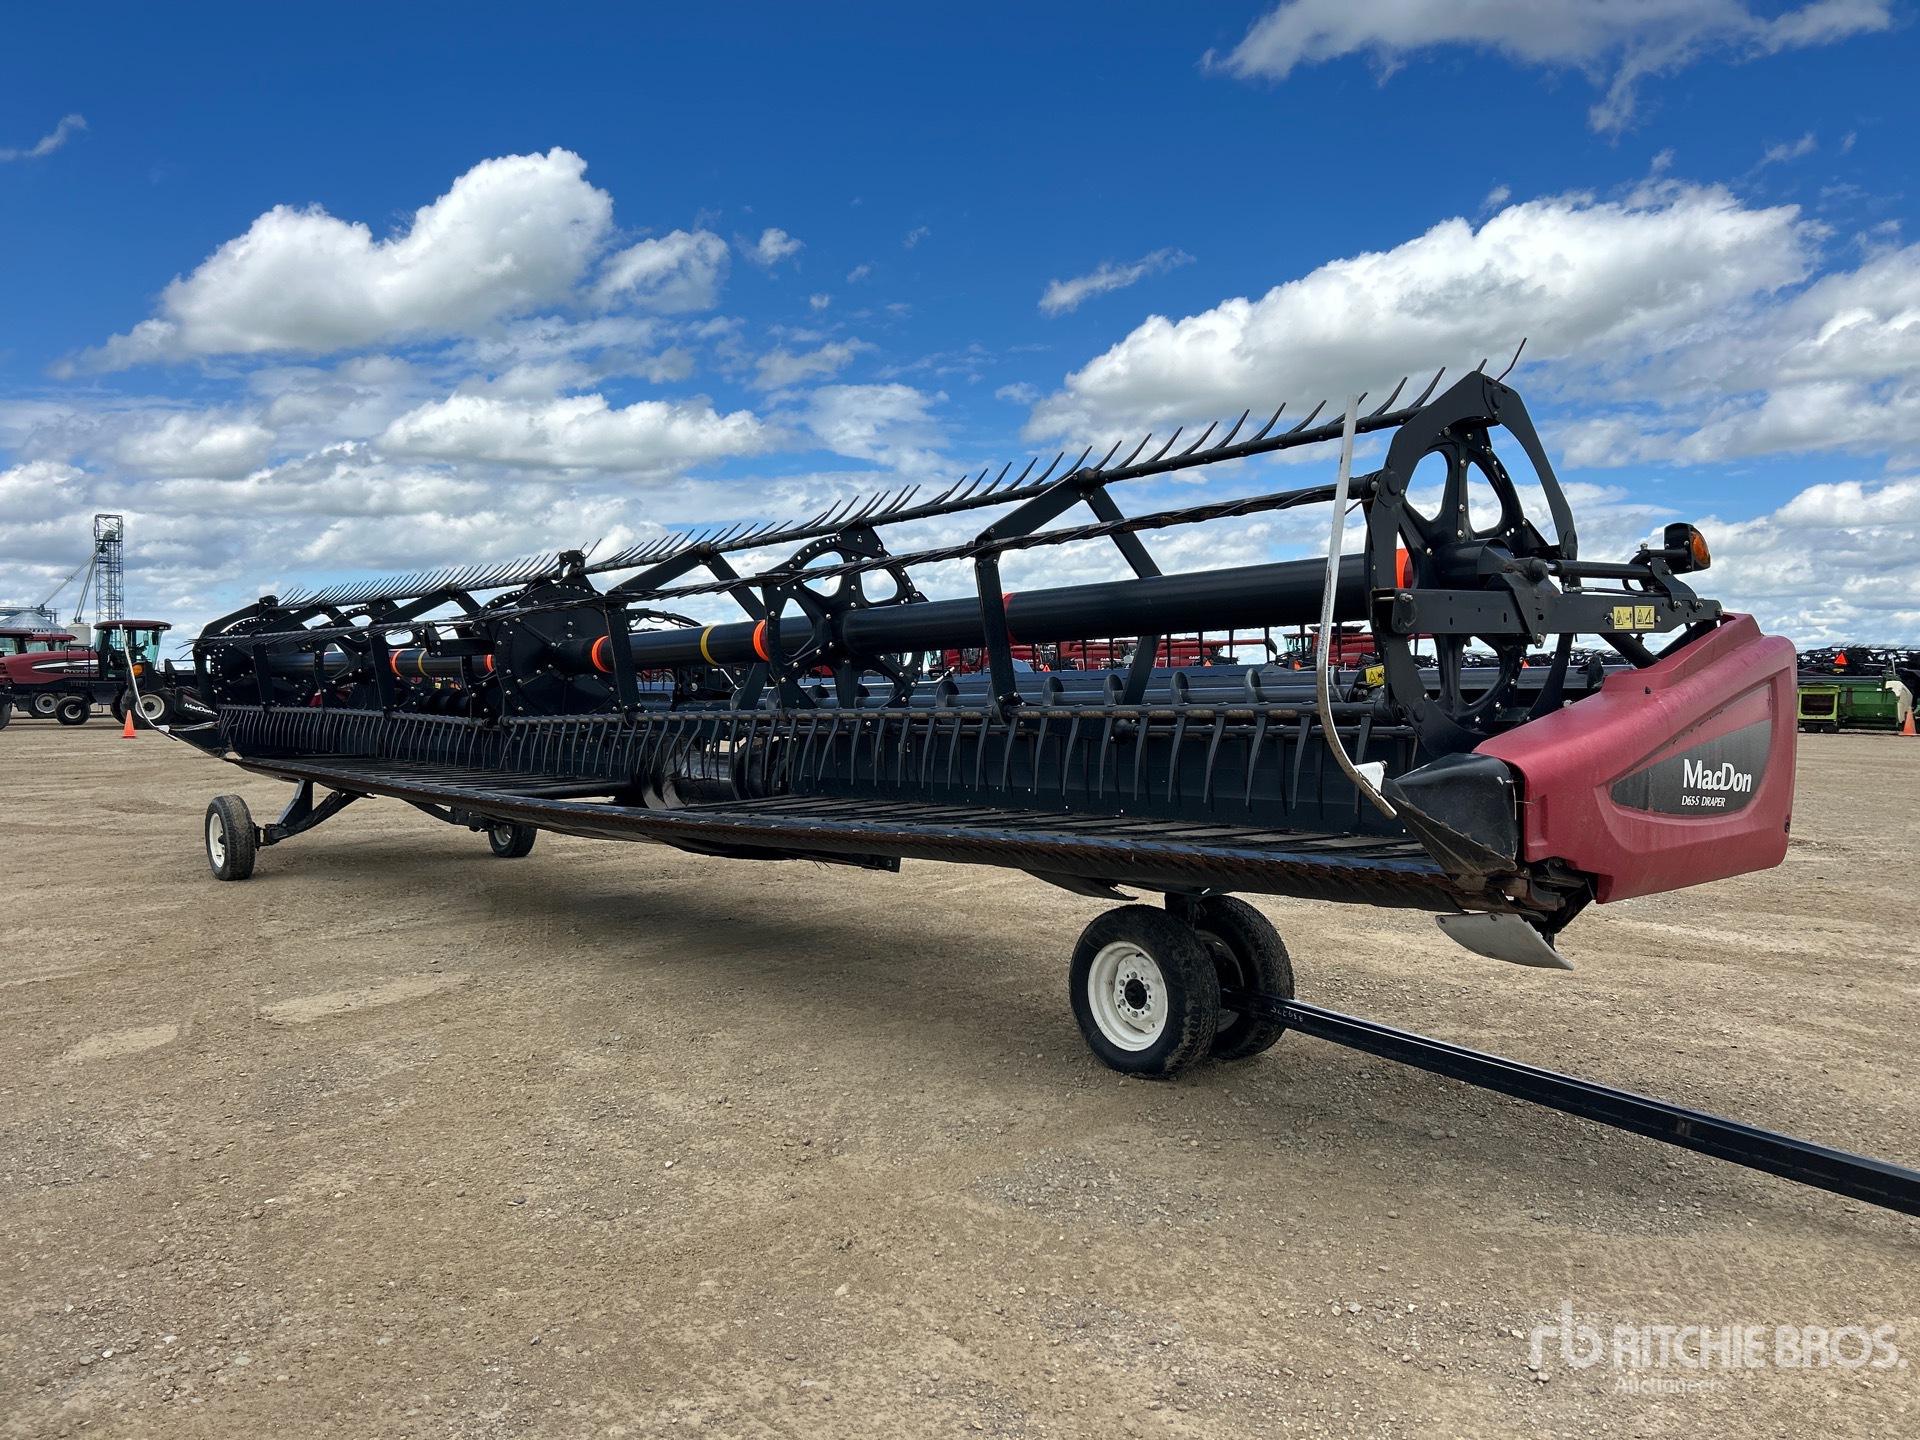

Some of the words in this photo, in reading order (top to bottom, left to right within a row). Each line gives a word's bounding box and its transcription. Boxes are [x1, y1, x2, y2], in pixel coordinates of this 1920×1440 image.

[184, 702, 213, 714] MacDon
[1683, 758, 1752, 793] MacDon
[1701, 796, 1726, 807] DRAPER
